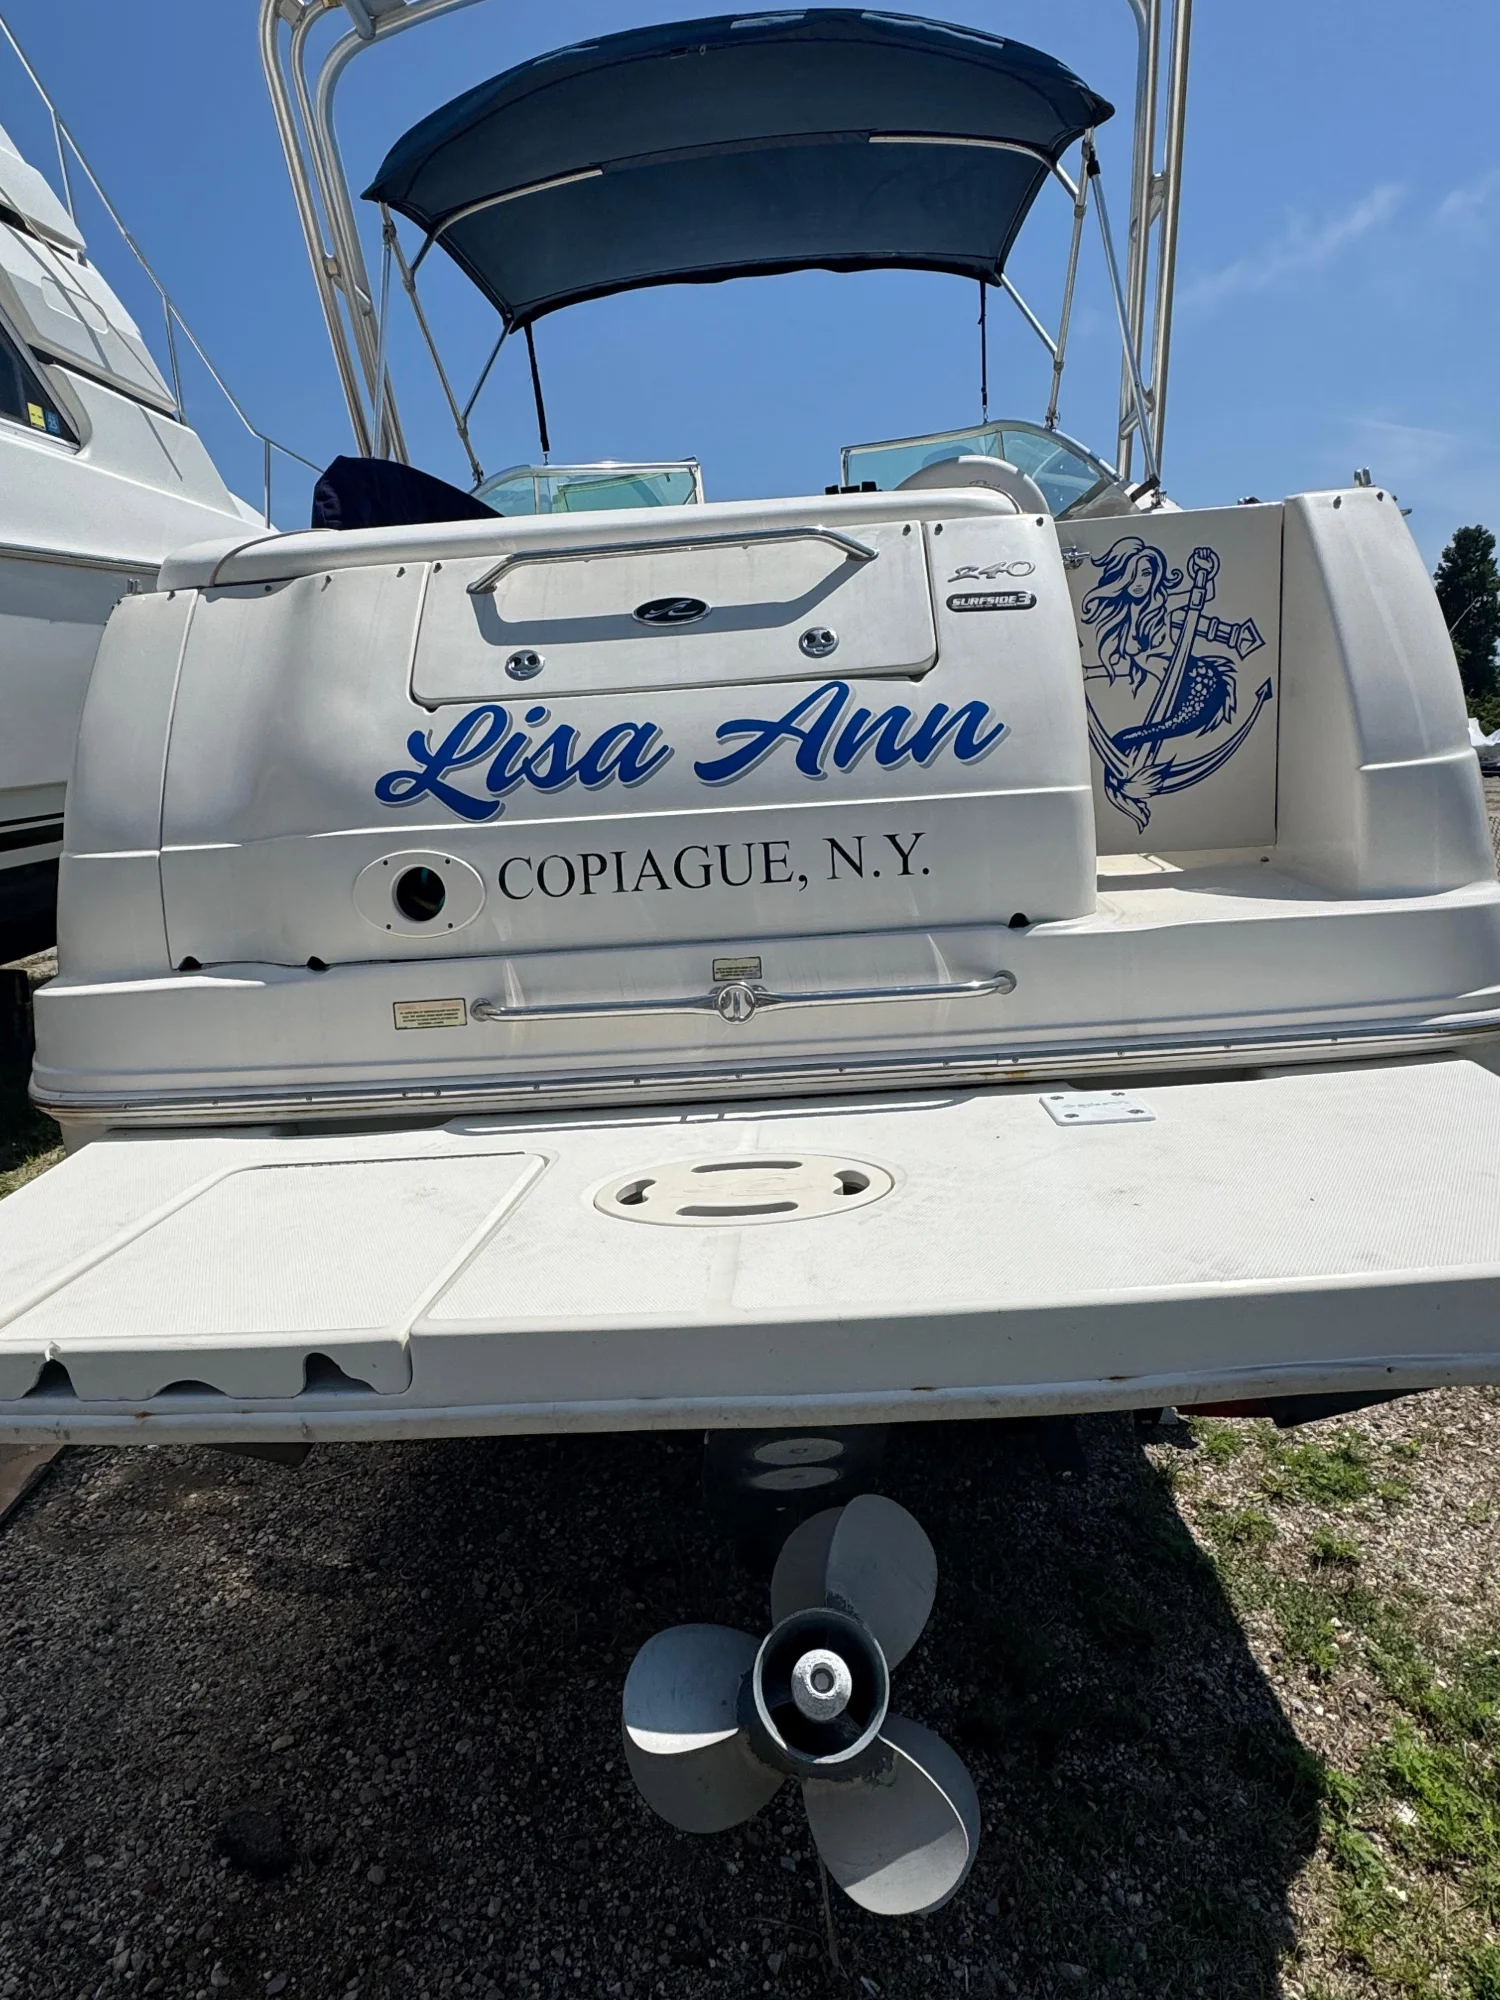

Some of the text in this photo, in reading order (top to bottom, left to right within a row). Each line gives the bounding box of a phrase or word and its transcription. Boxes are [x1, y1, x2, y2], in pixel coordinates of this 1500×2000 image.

[947, 561, 1036, 583] 240
[374, 680, 1012, 824] Lisa Ann
[498, 832, 931, 900] COPIAGUE, N.Y.
